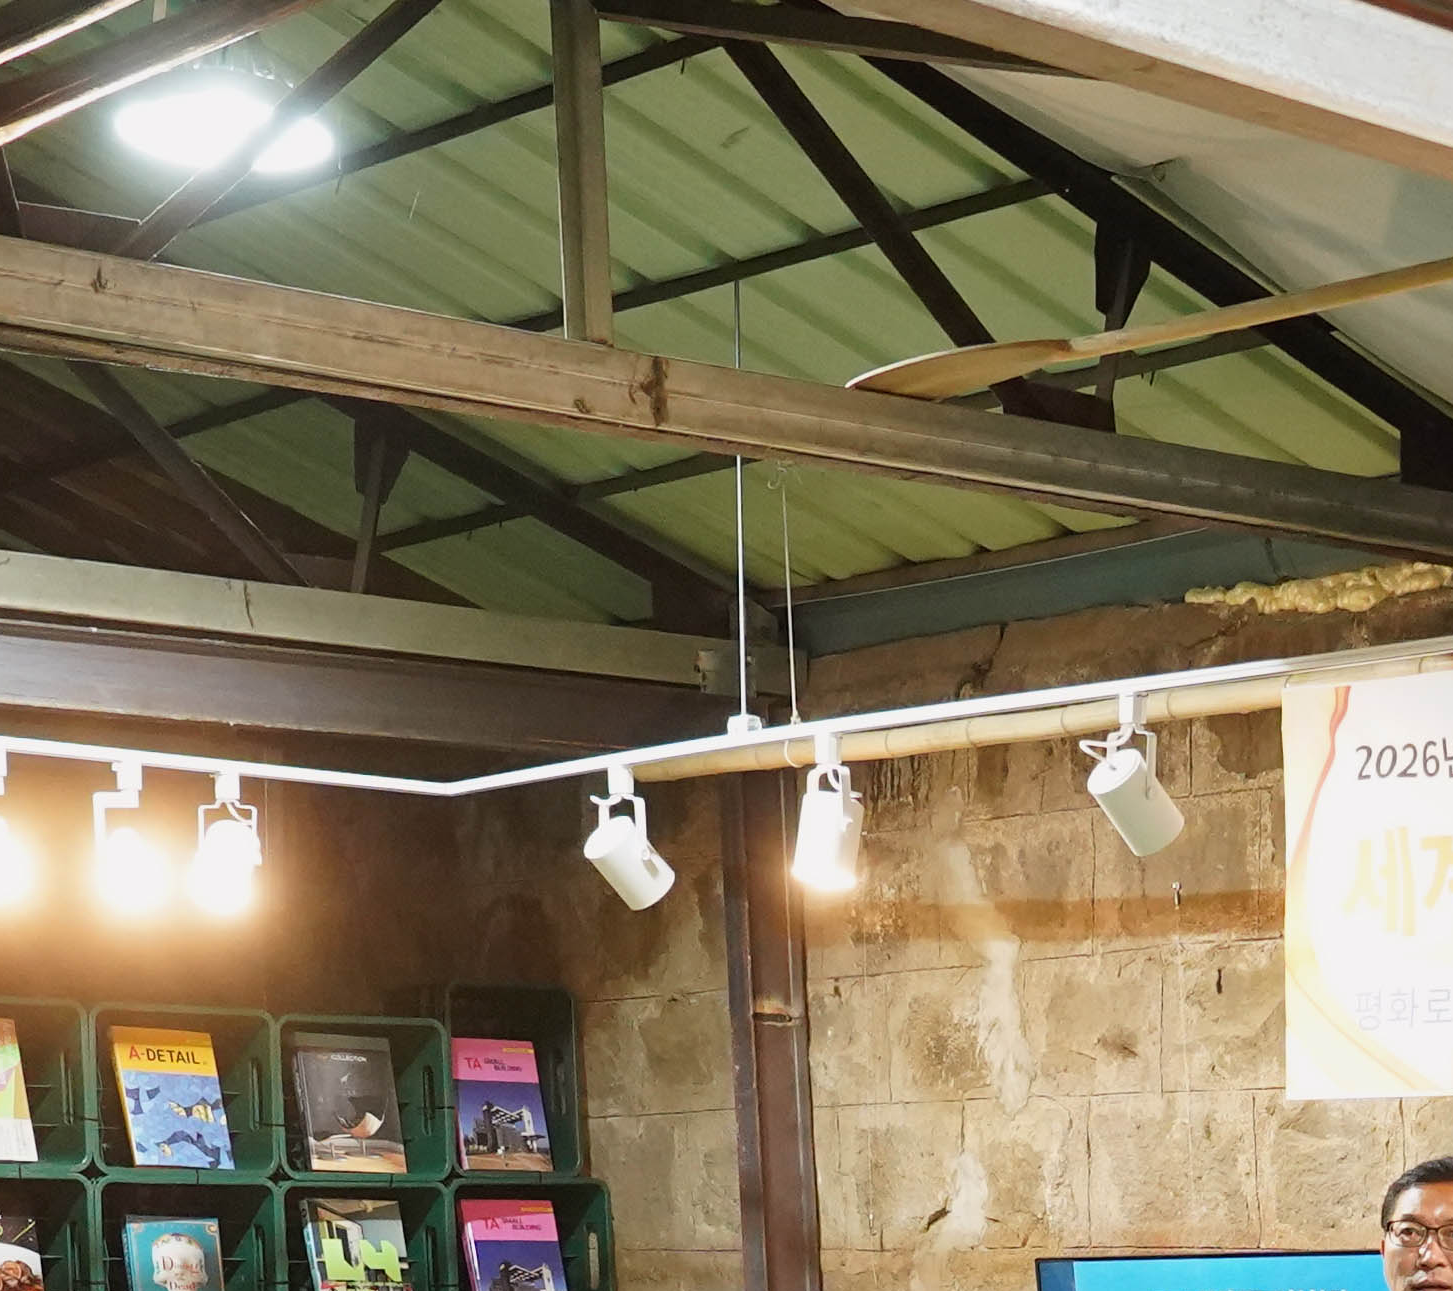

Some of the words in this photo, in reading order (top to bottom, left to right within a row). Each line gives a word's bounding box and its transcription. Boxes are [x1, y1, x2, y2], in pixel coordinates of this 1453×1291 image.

[129, 1044, 201, 1065] A-DETAIL
[465, 1056, 482, 1071] TA
[483, 1216, 500, 1230] TA
